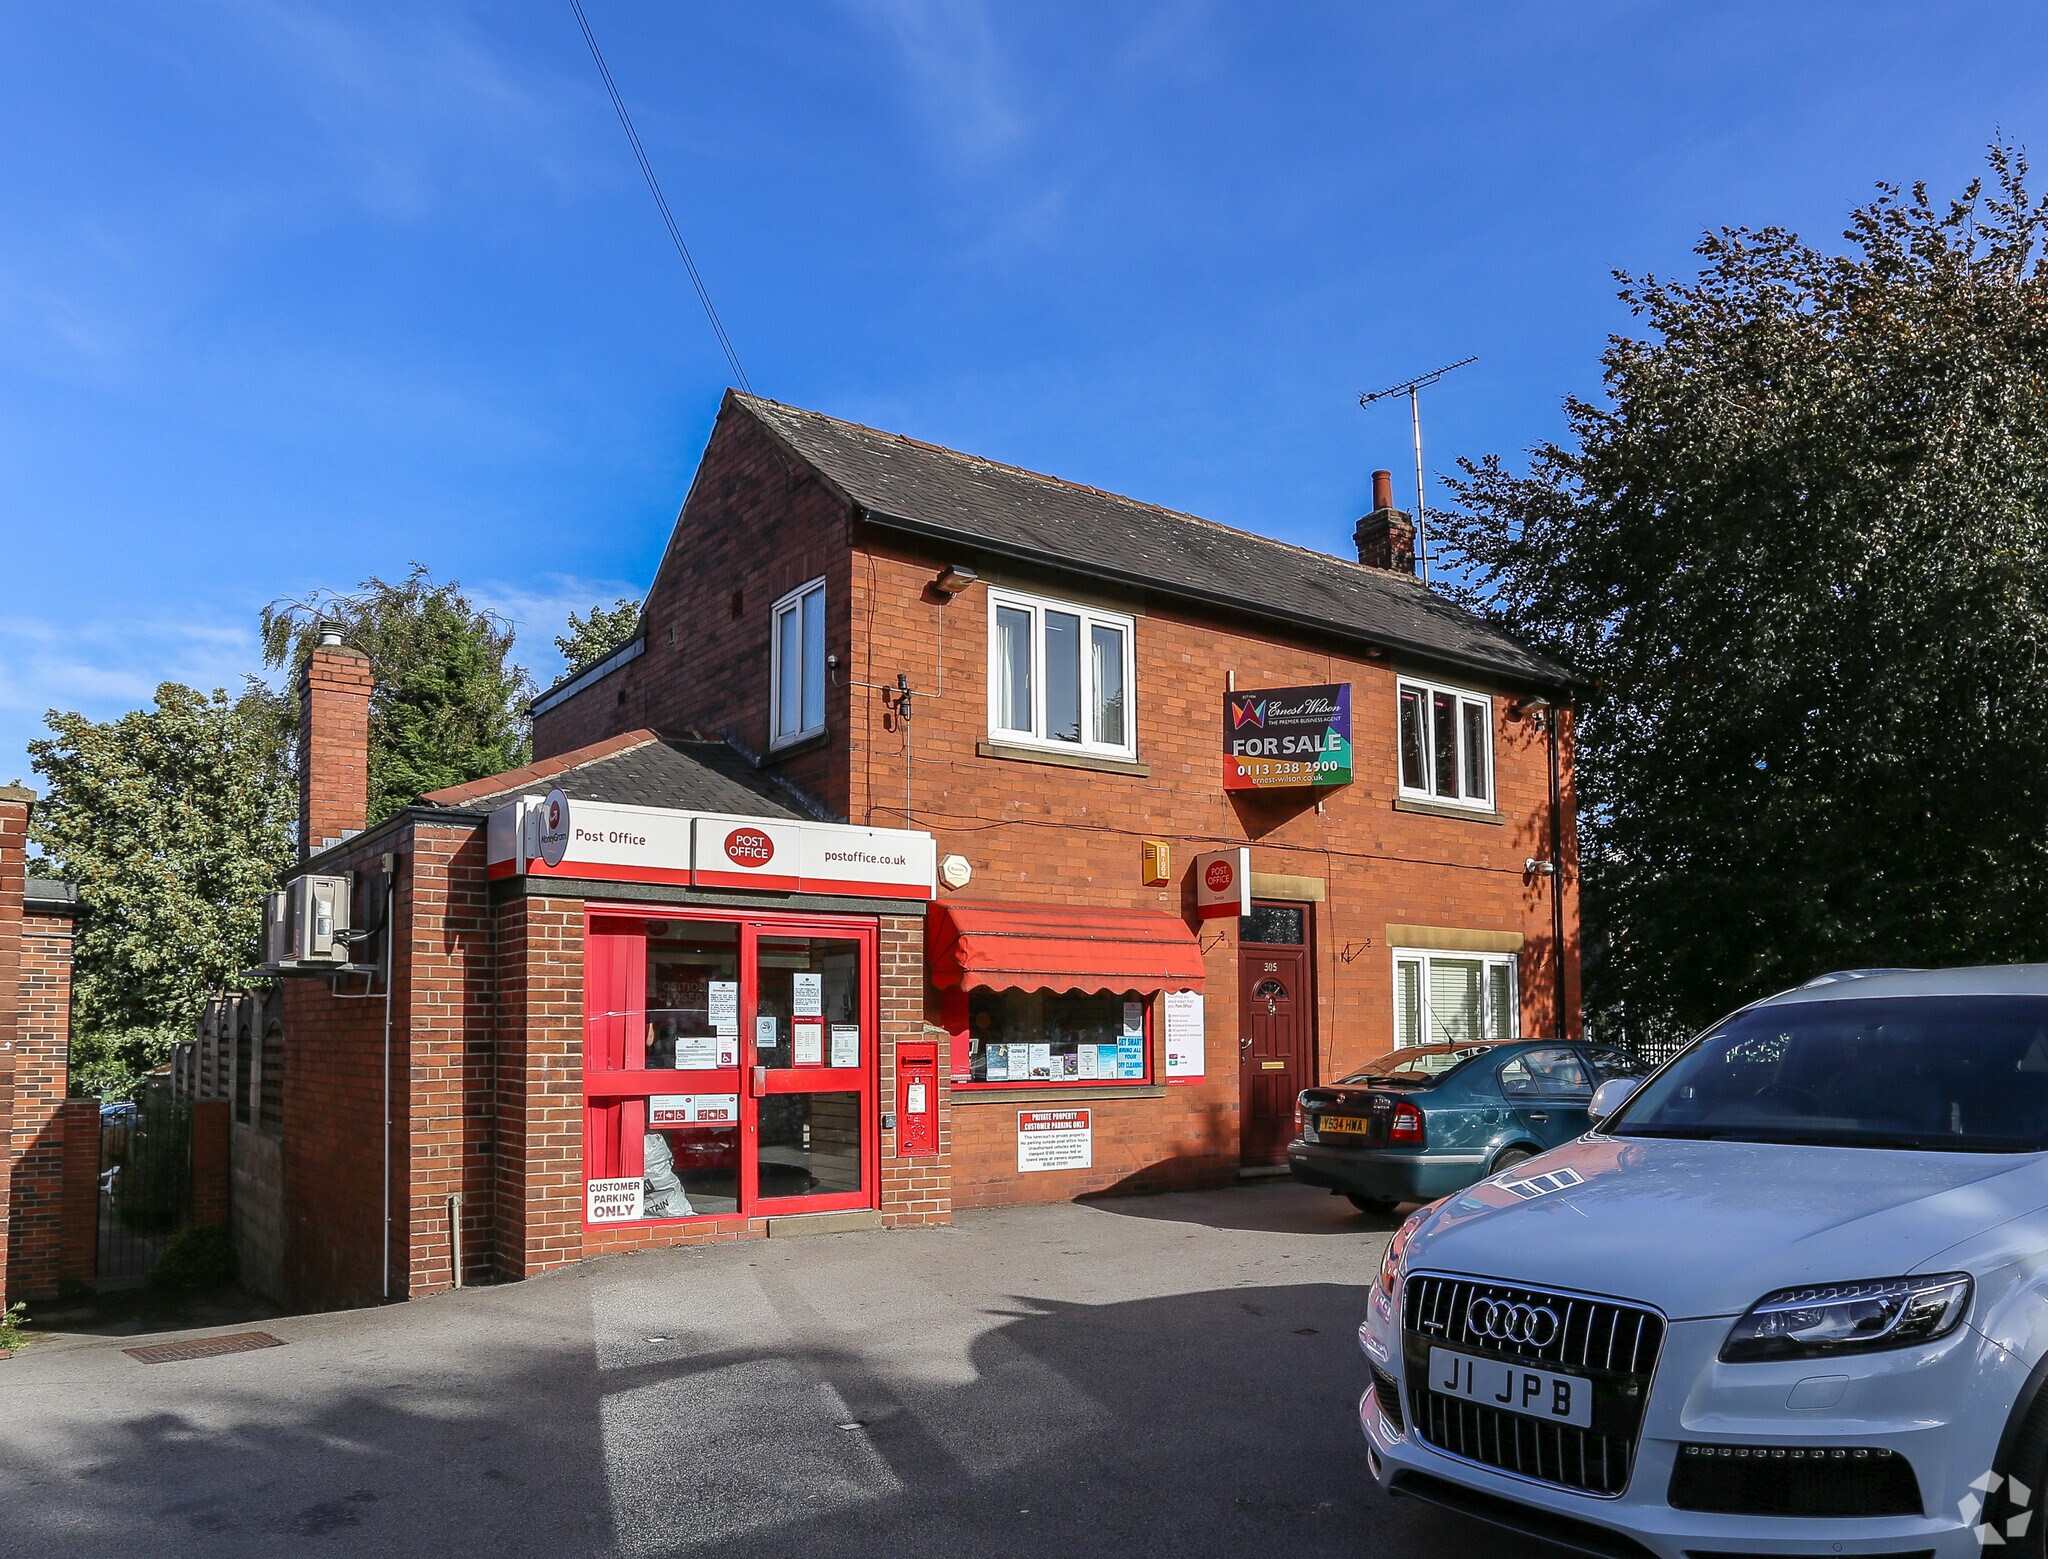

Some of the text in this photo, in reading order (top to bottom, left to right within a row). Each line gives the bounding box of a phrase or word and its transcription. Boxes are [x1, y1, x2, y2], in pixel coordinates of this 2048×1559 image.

[1267, 698, 1342, 717] Ernest Wilson
[1233, 733, 1342, 757] FOR SALE
[1237, 760, 1338, 776] 0113 238 2900
[1252, 773, 1324, 785] ernest-wilson.co.uk
[541, 832, 567, 845] MoneyGram
[575, 828, 646, 846] Post Office
[735, 835, 765, 848] POST
[728, 845, 769, 859] OFFICE
[824, 850, 906, 866] postoffice.co.uk
[1211, 866, 1227, 876] POST
[1207, 874, 1230, 885] OFFICE
[1263, 962, 1278, 972] 305
[658, 992, 703, 1002] CLOSED
[1118, 1038, 1142, 1046] GET SMART
[1032, 1112, 1077, 1121] PRIVATE PROPERTY
[1024, 1122, 1051, 1130] CUSTOMER
[1051, 1121, 1073, 1129] PARKING
[1323, 1118, 1363, 1132] Y534 HWA
[589, 1181, 640, 1193] CUSTOMER
[594, 1193, 635, 1204] PARKING
[593, 1204, 635, 1218] ONLY
[643, 1198, 669, 1216] NTAIN
[1494, 1369, 1572, 1417] JPB
